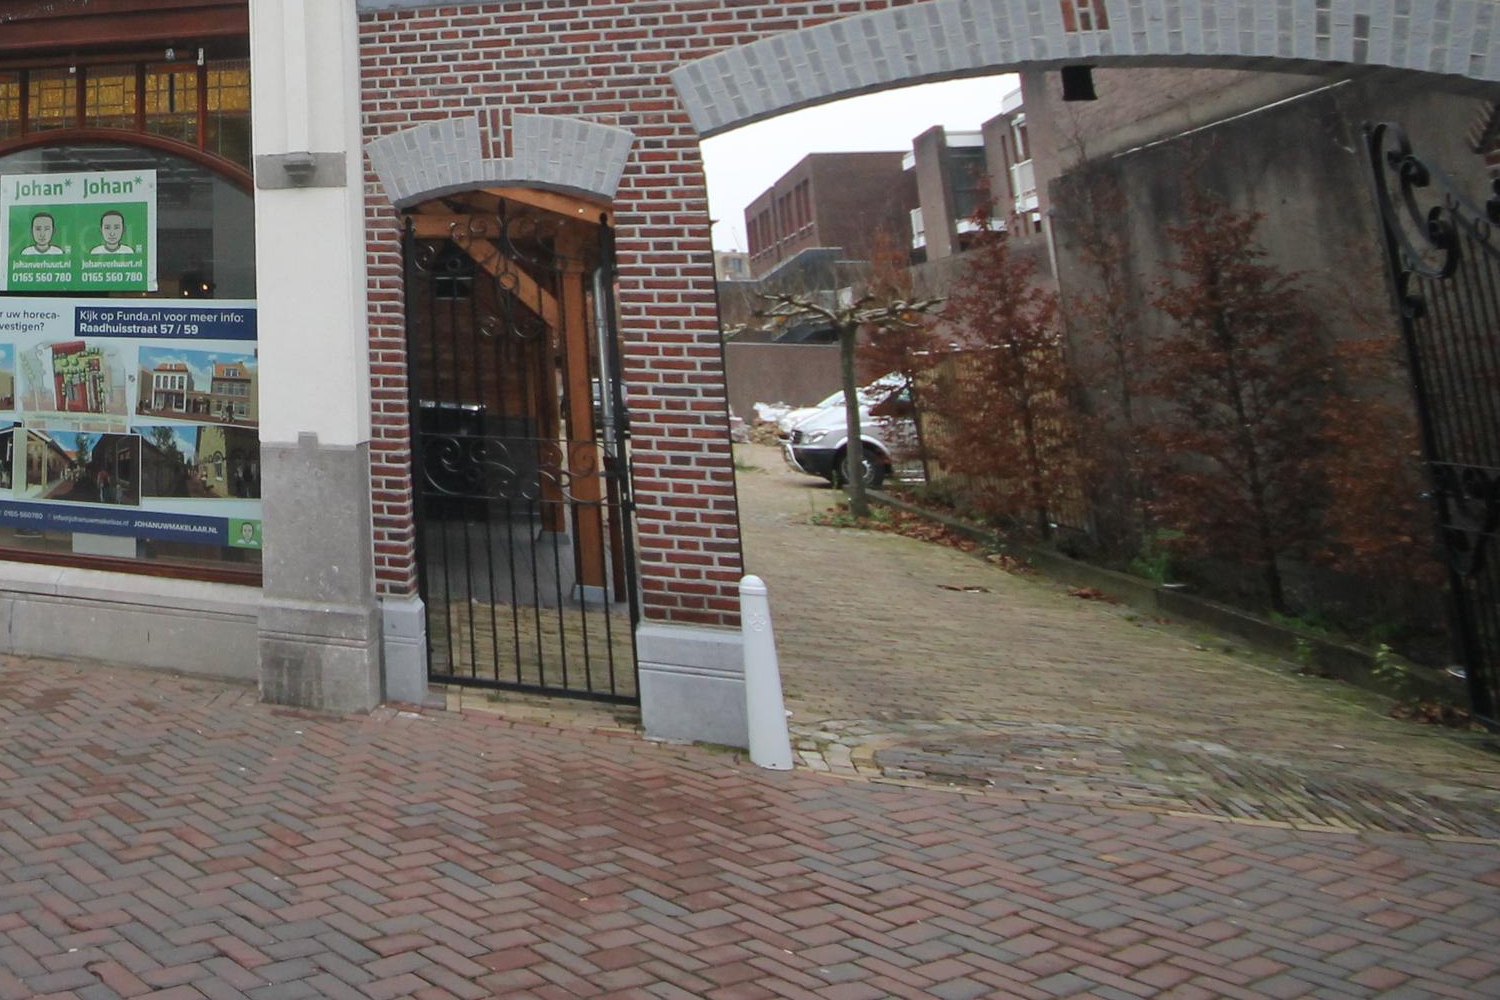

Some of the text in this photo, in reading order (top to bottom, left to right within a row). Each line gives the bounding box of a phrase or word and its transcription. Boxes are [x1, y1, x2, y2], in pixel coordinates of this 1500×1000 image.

[12, 272, 72, 283] 0165 560 780
[81, 271, 143, 282] 0165 560 780
[6, 311, 20, 319] uw
[23, 309, 60, 320] horeca-
[80, 310, 244, 323] Kijk op Funda.nl voor meer info:
[0, 321, 45, 333] vestigen?
[79, 323, 157, 334] Raadhuisstraat
[160, 324, 174, 334] 57
[183, 324, 199, 335] 59
[133, 520, 218, 535] JOHANUWMAKELAAR.NL
